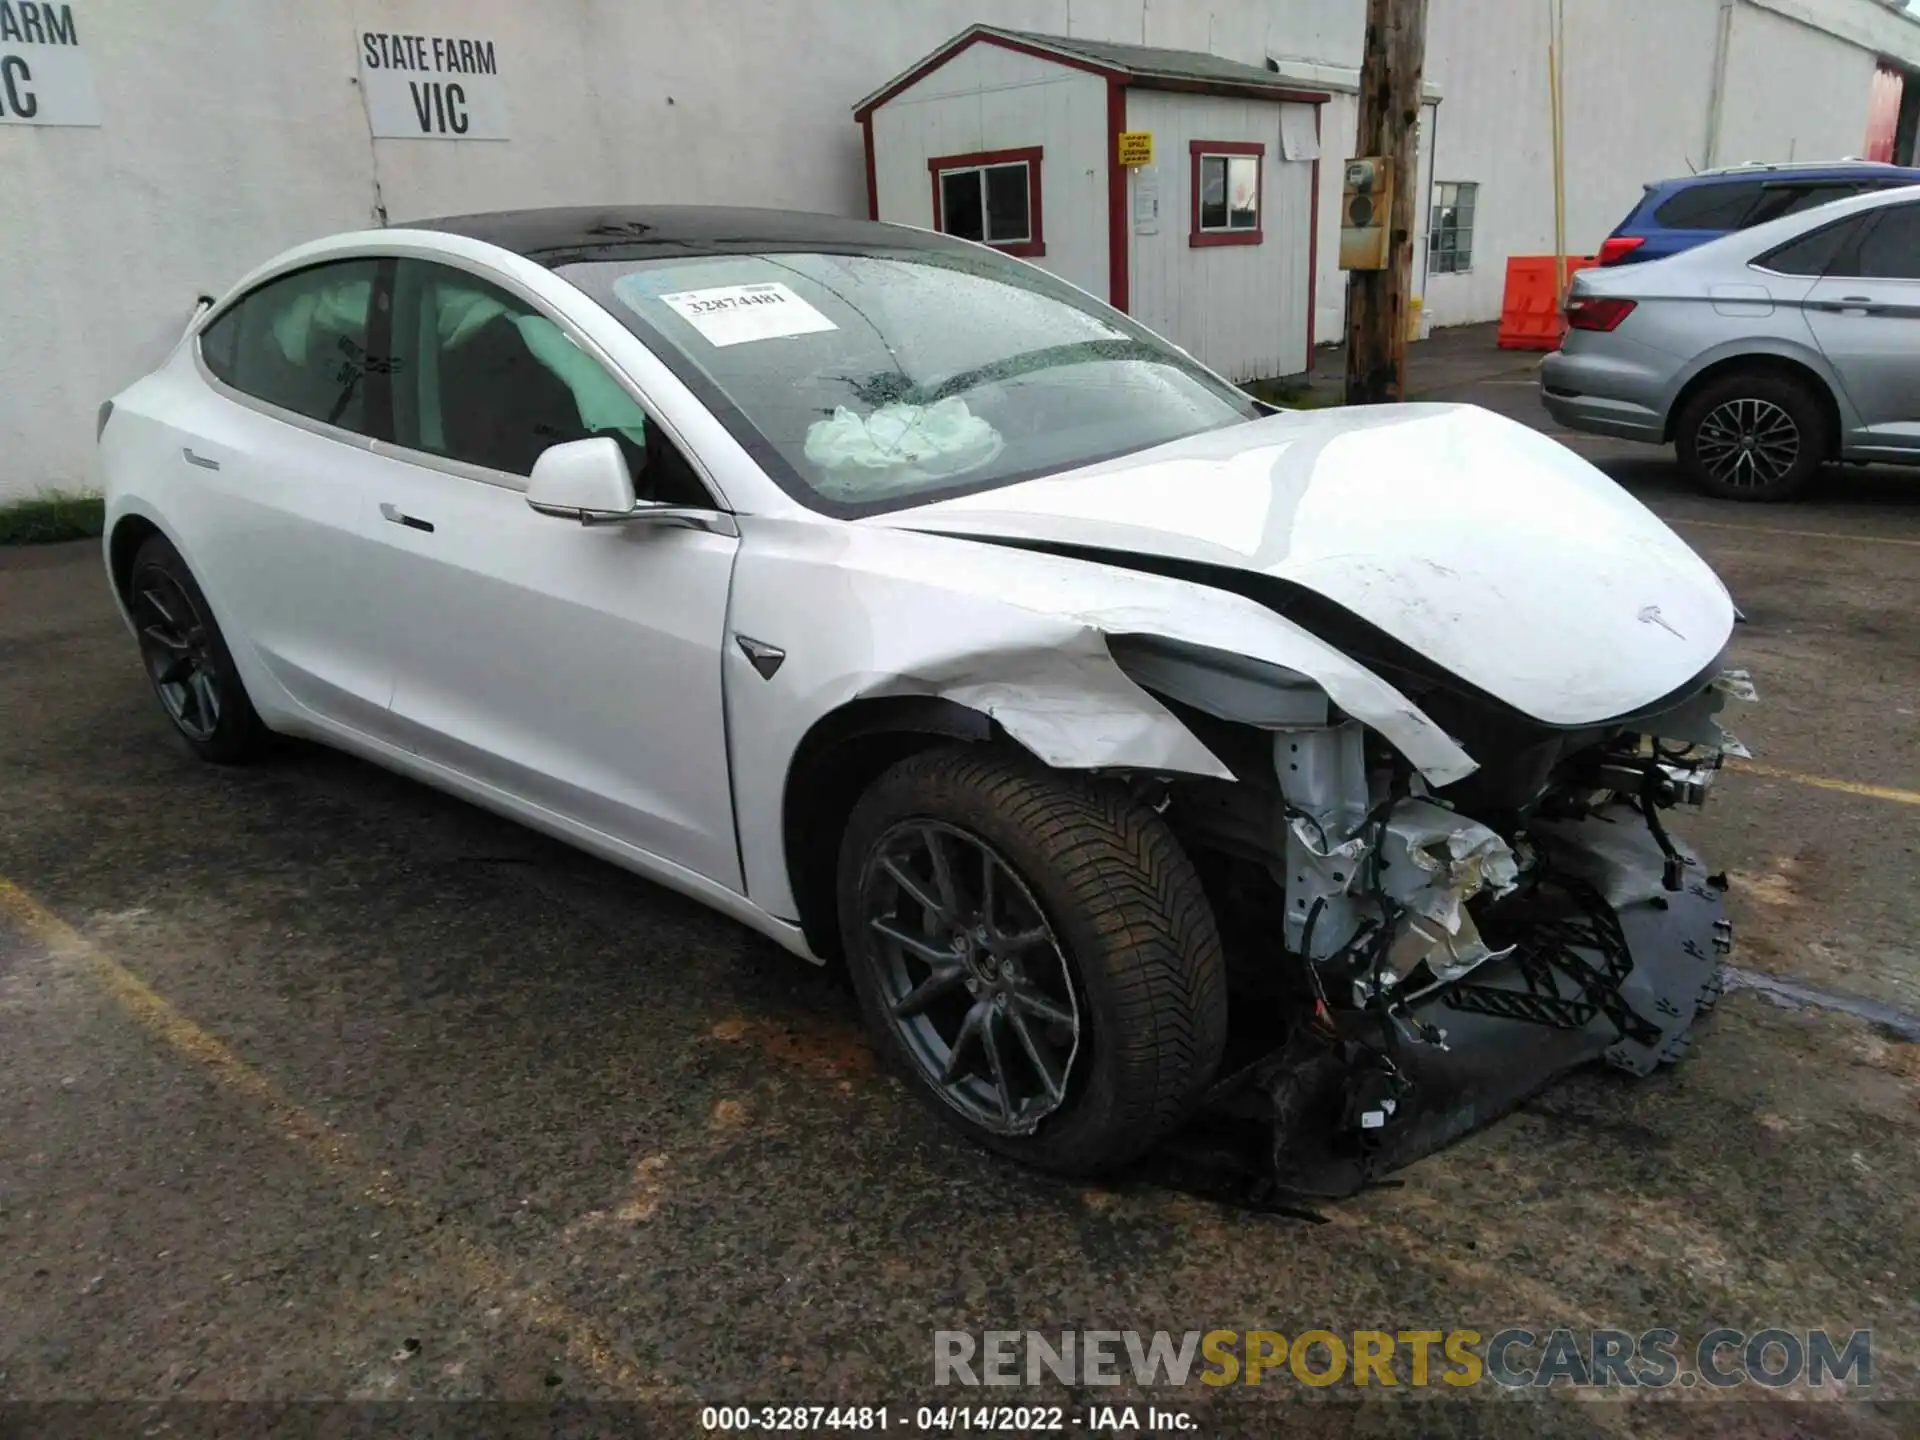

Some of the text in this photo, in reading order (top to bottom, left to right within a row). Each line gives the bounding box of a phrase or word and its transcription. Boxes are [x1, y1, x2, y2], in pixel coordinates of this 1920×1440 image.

[363, 32, 497, 75] STATE FARM
[0, 55, 37, 118] C
[408, 81, 469, 134] VIC
[686, 292, 788, 313] 32874481
